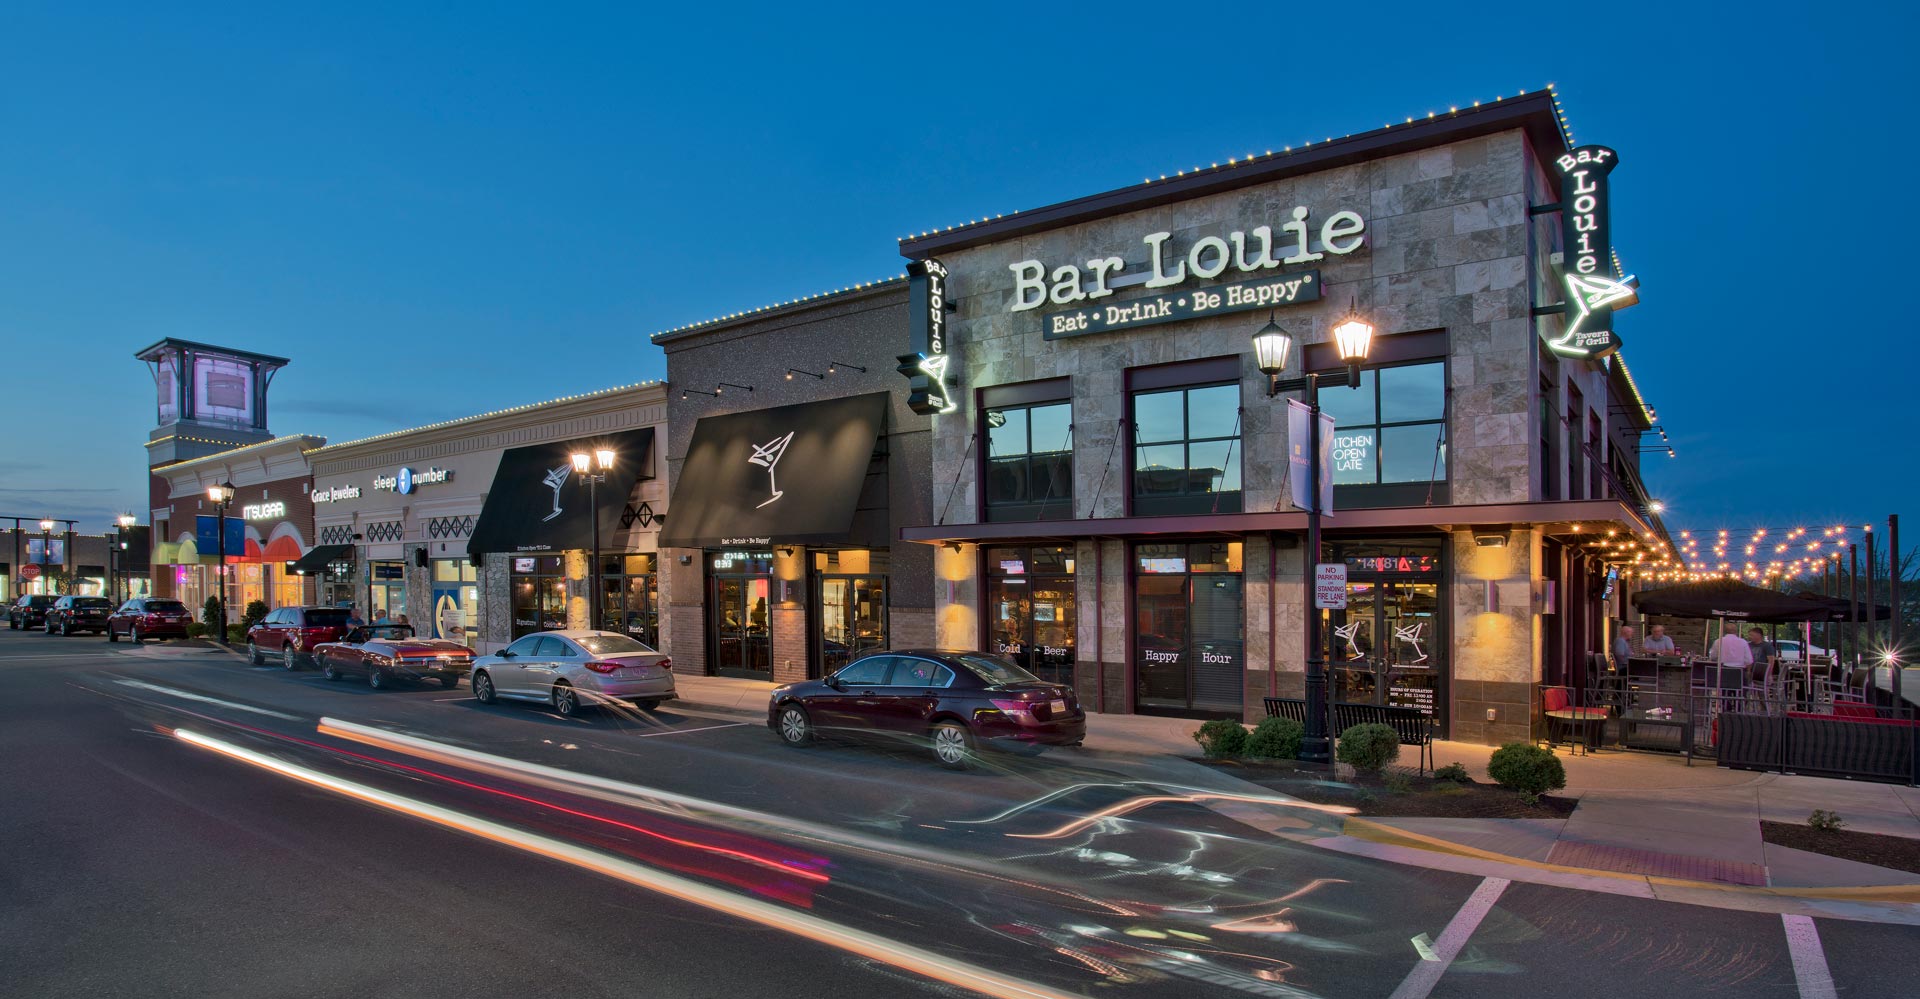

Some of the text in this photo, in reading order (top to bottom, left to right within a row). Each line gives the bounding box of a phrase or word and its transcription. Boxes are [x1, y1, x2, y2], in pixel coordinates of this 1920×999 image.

[1557, 149, 1611, 172] Bar
[1572, 170, 1597, 274] Louie
[1009, 206, 1366, 313] Bar Louie
[924, 260, 948, 278] Bar
[931, 276, 943, 354] Louie
[1052, 313, 1087, 334] Eat
[1106, 299, 1173, 326] Drink
[1192, 291, 1221, 312] Be
[1575, 330, 1610, 340] Tavern
[1576, 337, 1610, 347] & Grill
[1334, 435, 1372, 449] ITCHEN
[1333, 448, 1366, 460] OPEN
[1337, 459, 1363, 471] LATE
[373, 467, 447, 492] sleep number
[311, 484, 360, 503] Grace Jewelers
[1317, 592, 1345, 600] FIRE LANE
[629, 625, 644, 633] Music
[999, 643, 1067, 656] Cold Beer
[1145, 650, 1232, 664] Happy Hour
